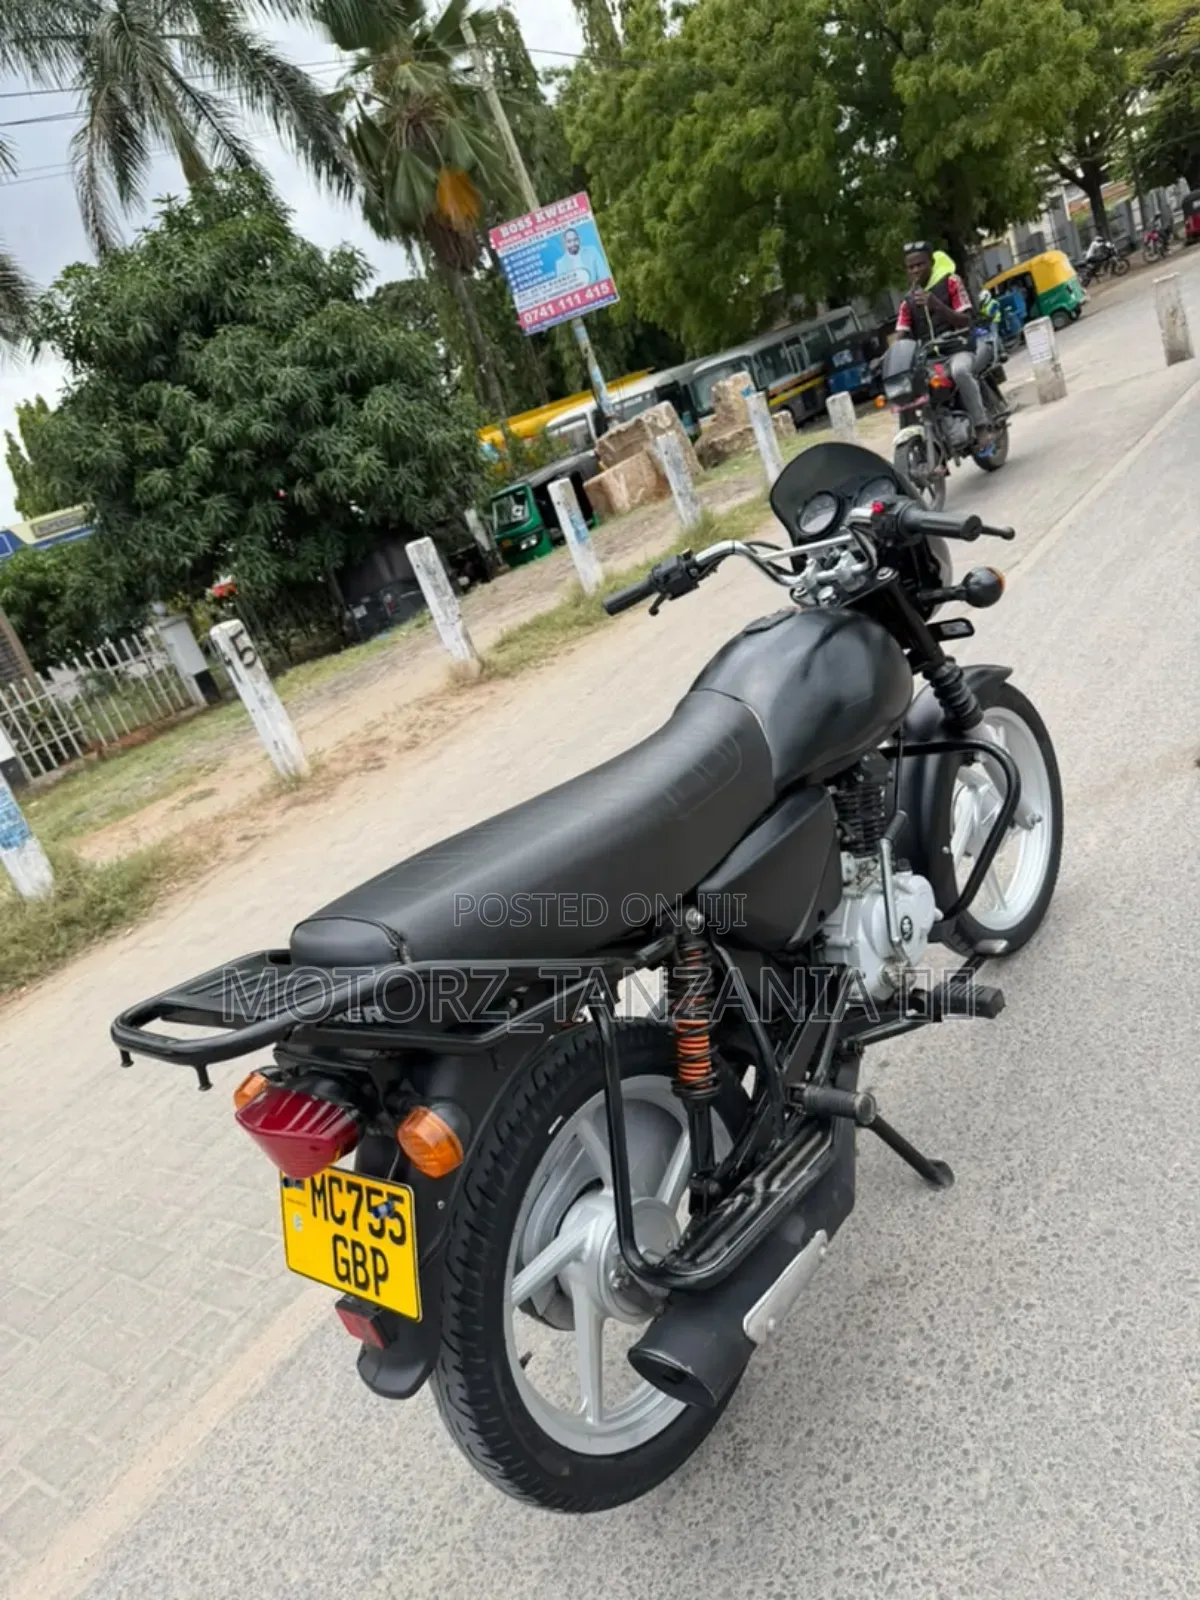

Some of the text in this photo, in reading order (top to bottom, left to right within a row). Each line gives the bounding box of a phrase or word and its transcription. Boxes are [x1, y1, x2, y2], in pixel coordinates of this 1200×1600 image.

[500, 216, 533, 237] BOSS
[523, 304, 554, 324] 0741
[558, 294, 582, 309] 111
[585, 281, 610, 299] 415
[310, 1173, 407, 1246] MC755
[332, 1233, 389, 1297] GBP
